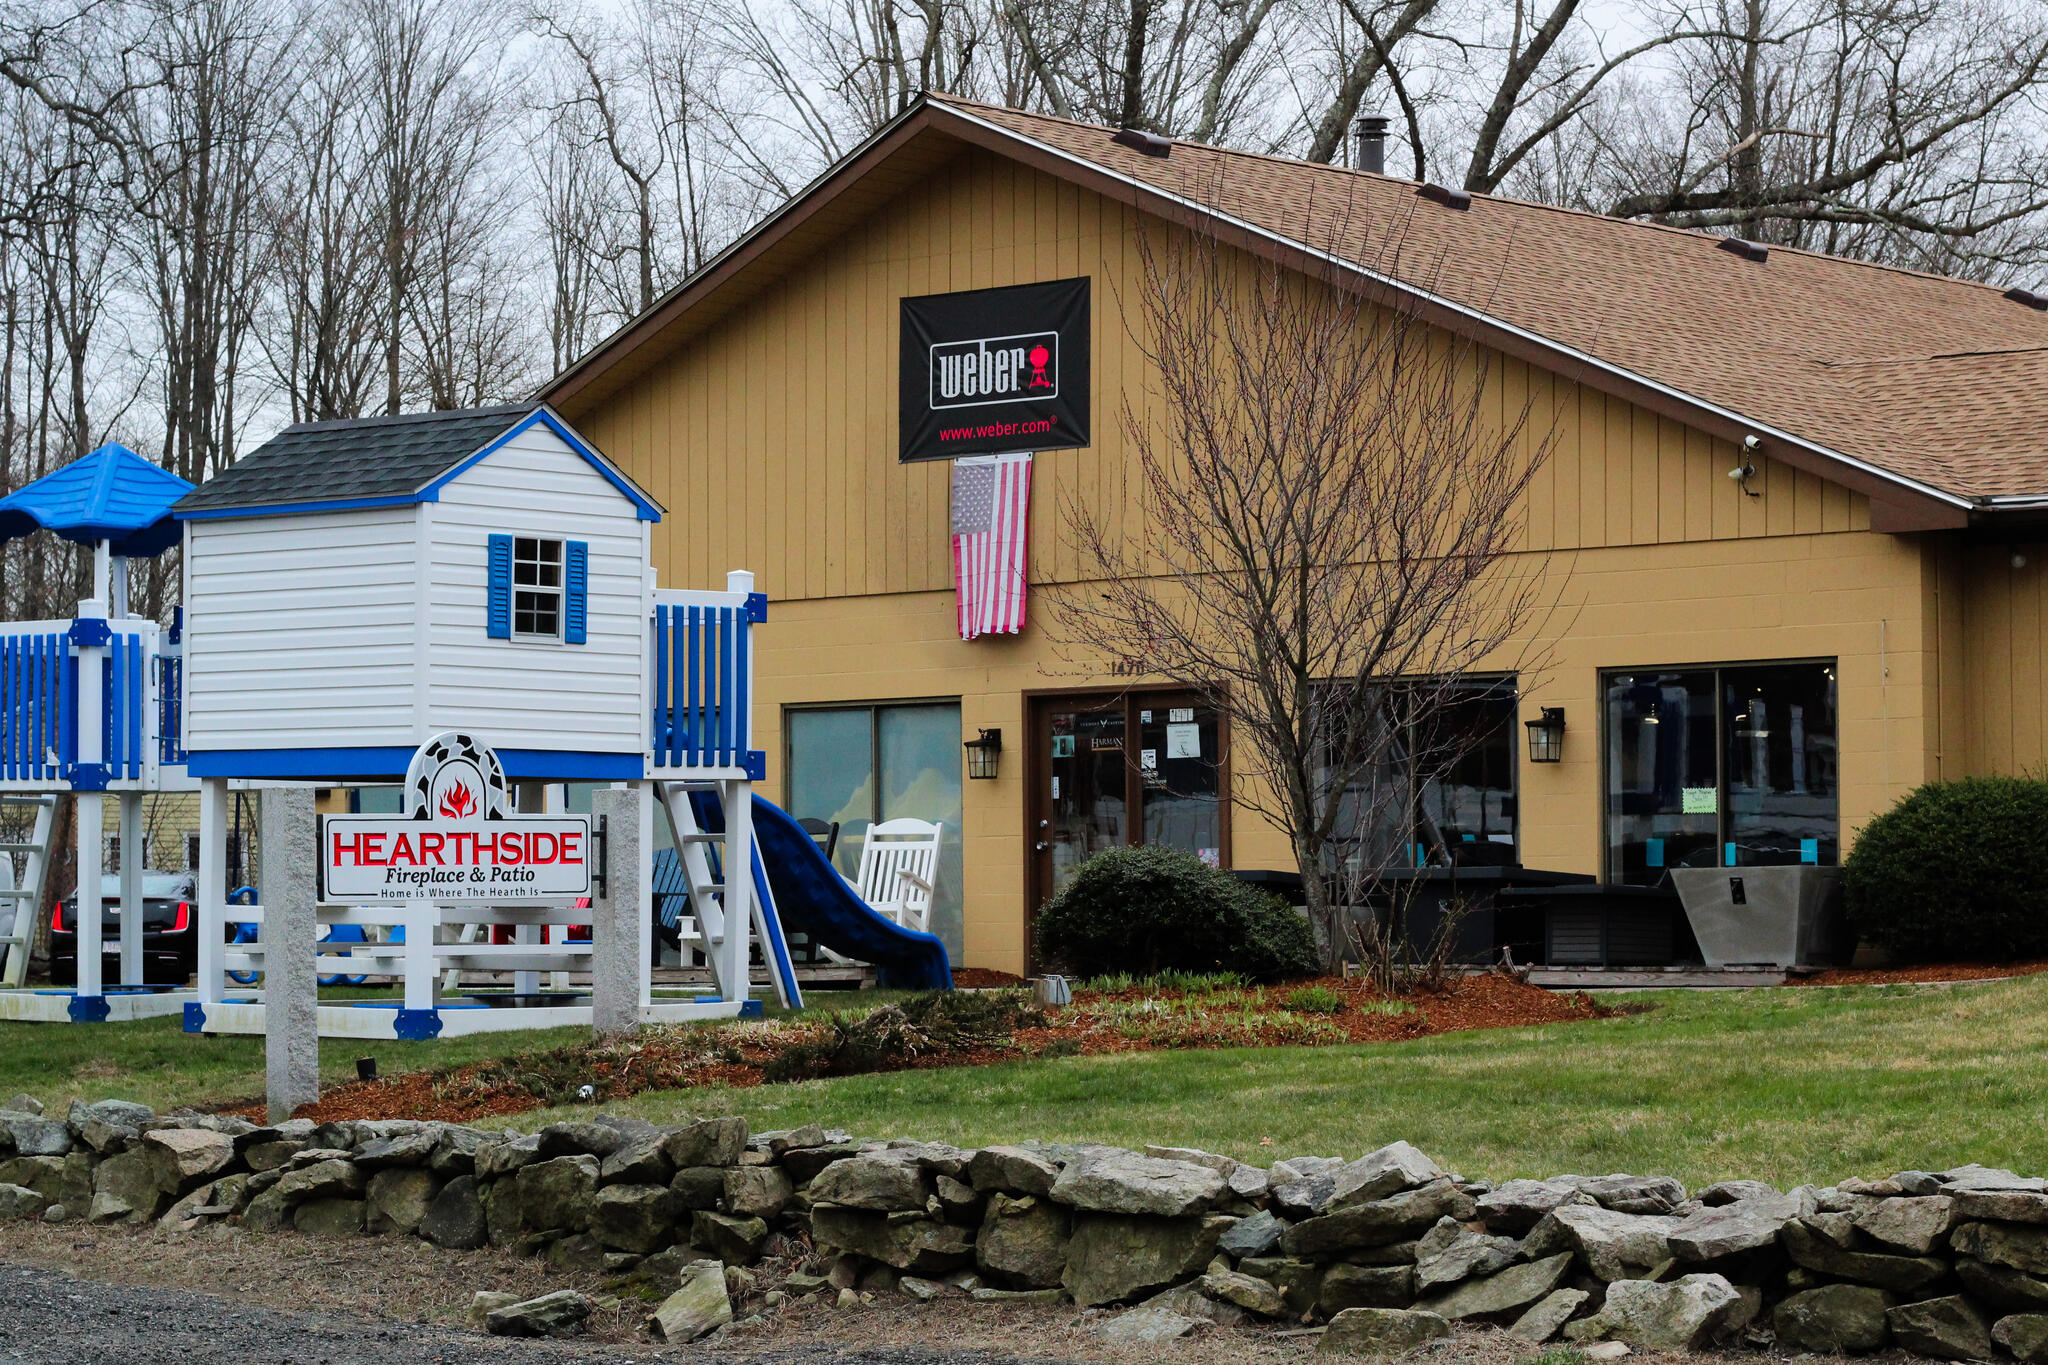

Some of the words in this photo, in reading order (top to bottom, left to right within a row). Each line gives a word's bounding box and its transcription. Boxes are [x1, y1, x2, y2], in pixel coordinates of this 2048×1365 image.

[939, 341, 1025, 398] weber
[939, 420, 1050, 441] www.weber.com
[333, 832, 583, 867] HEARTHSIDE
[385, 867, 465, 887] Fireplace
[469, 867, 486, 883] &
[489, 866, 535, 882] Patio
[381, 888, 412, 898] Home
[416, 887, 425, 897] is
[428, 887, 463, 897] Where
[466, 887, 486, 897] The
[489, 886, 526, 896] Hearth
